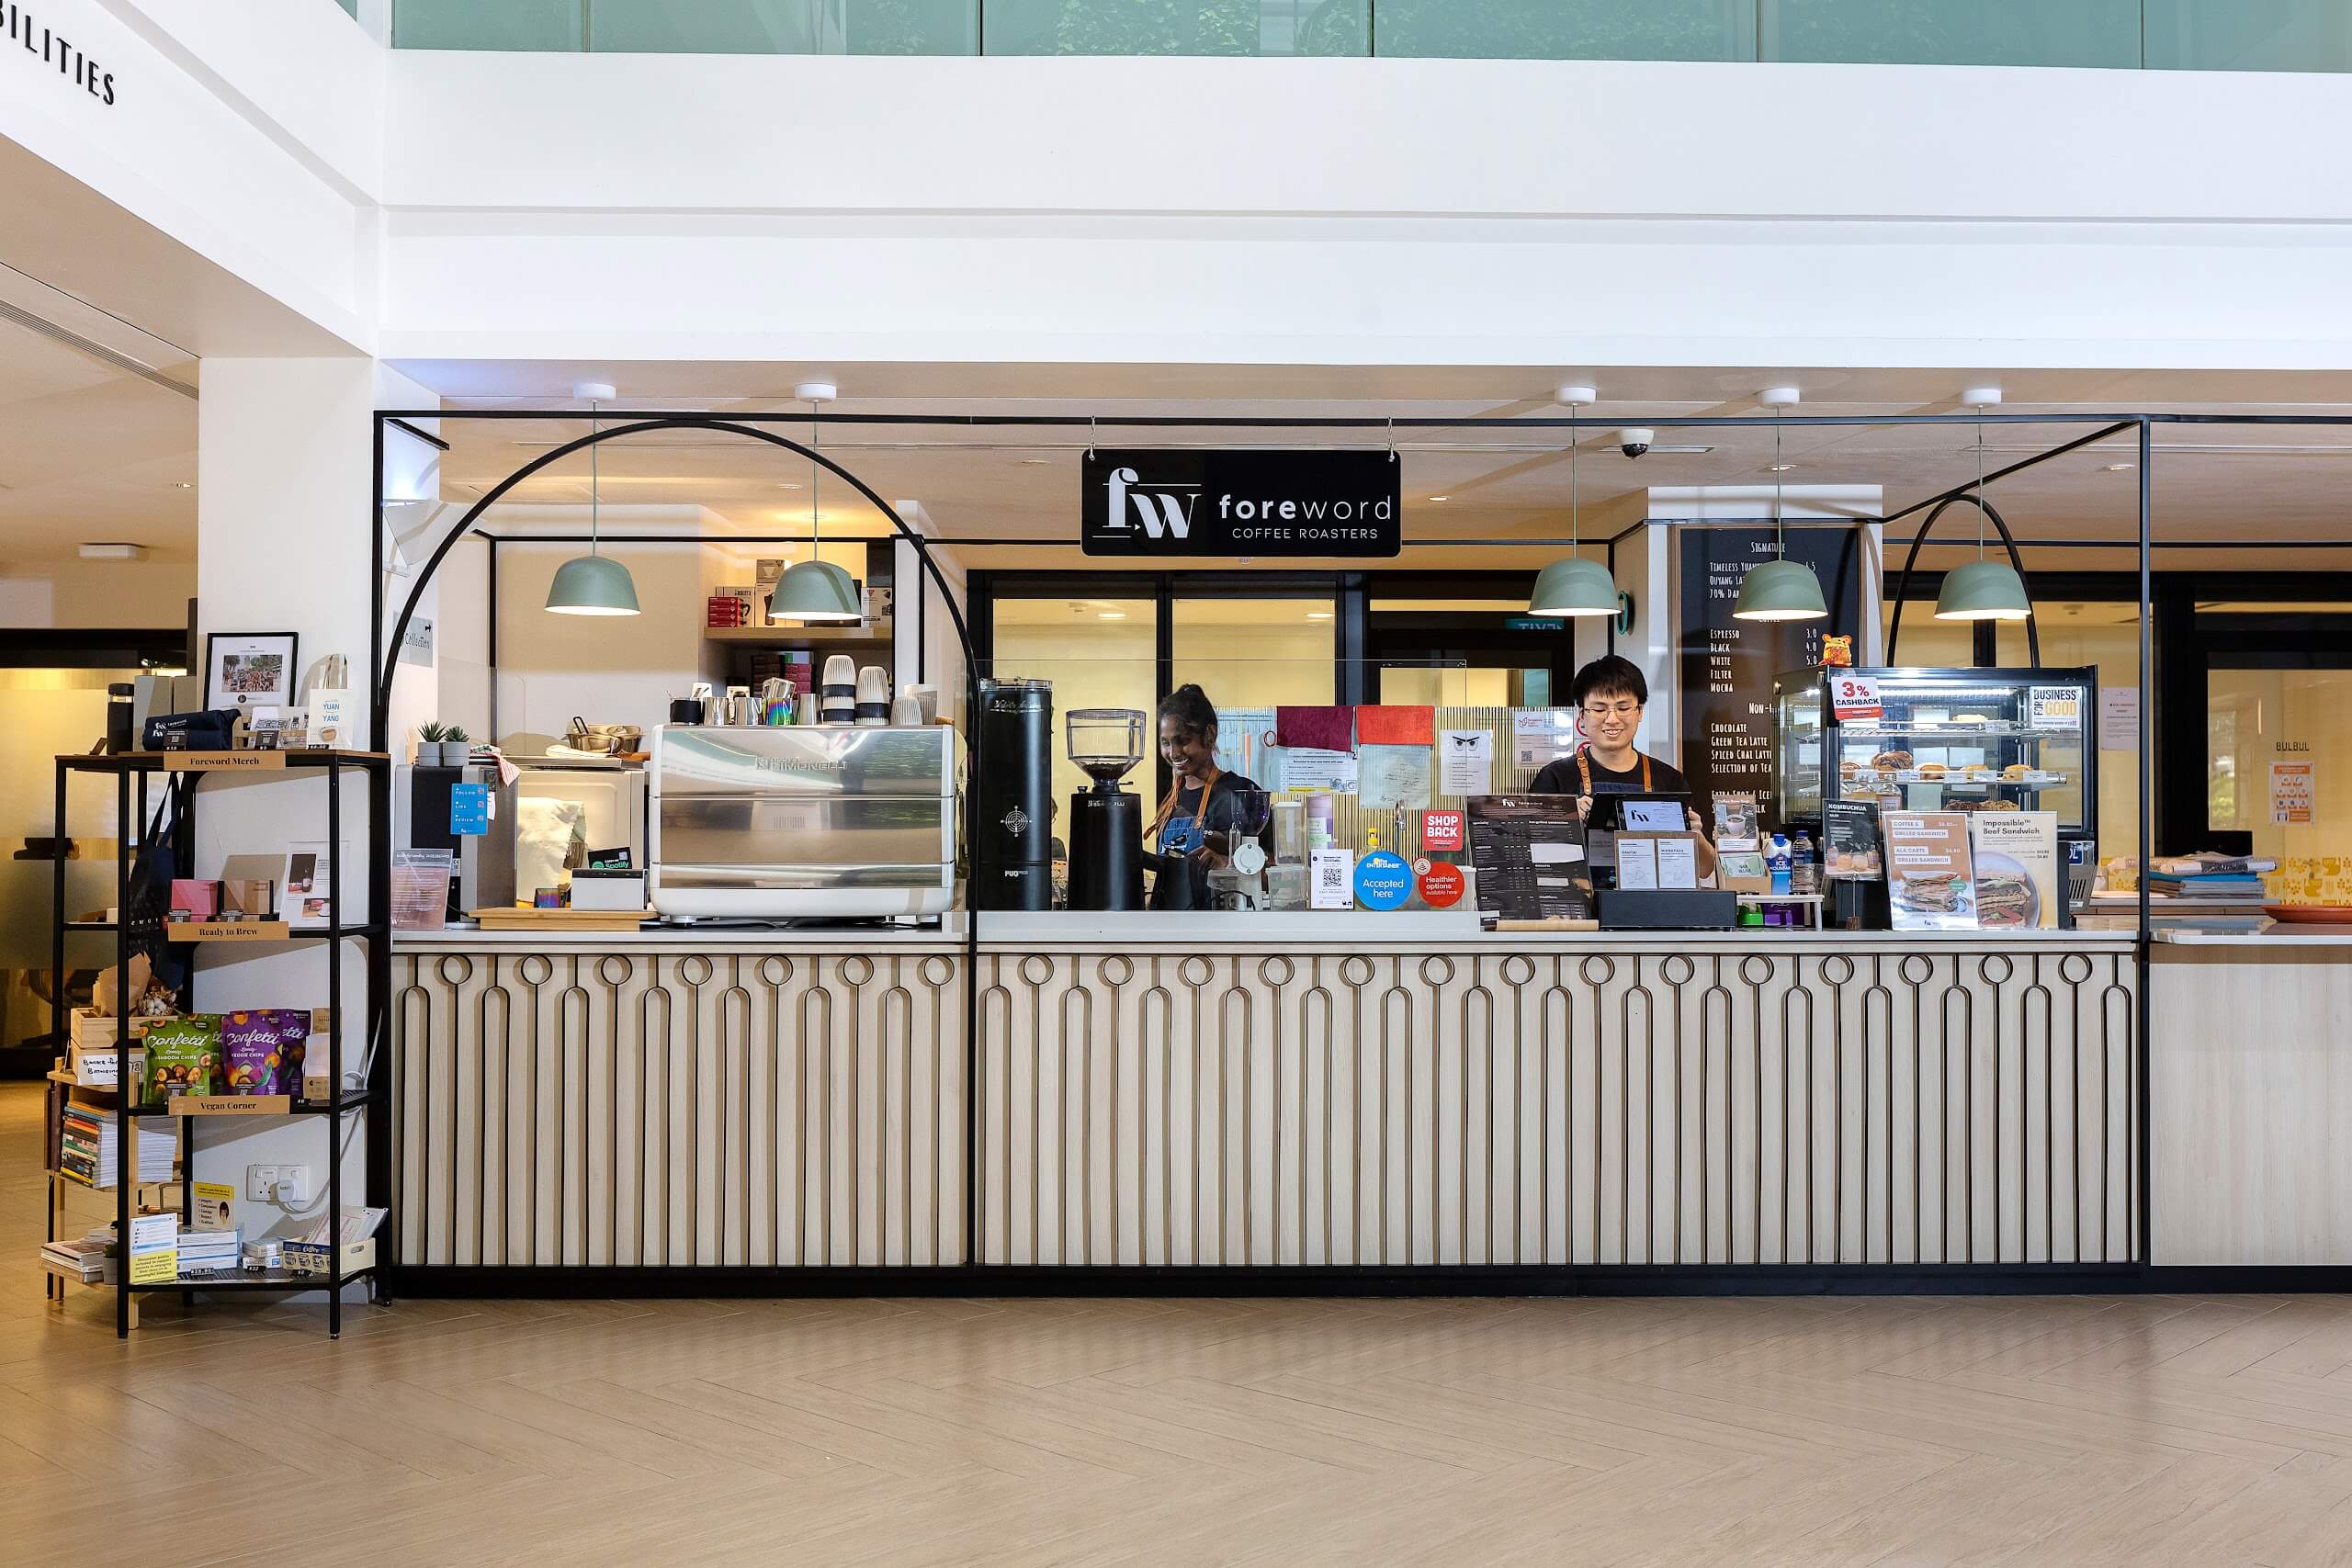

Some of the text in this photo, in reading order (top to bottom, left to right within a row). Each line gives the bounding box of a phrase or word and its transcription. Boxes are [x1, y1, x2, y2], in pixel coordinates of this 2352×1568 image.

[1219, 494, 1391, 520] foreword
[1232, 528, 1379, 539] COFFEE ROASTERS
[1750, 541, 1786, 553] SIGNATUE
[1710, 643, 1731, 653] BLACK
[1710, 656, 1731, 666] WHITE
[2033, 689, 2076, 701] BUSINESS
[1748, 703, 1771, 714] NON-
[2033, 701, 2043, 716] FOR
[2045, 701, 2077, 715] GOOD
[1711, 723, 1747, 733] CHOCOLATE
[1711, 736, 1768, 747] GREEN TEA LATTE
[2276, 741, 2310, 751] BULBUL
[1711, 750, 1735, 760] SPICED
[1736, 750, 1753, 760] CHAI
[190, 757, 259, 765] Foreword Merch
[1711, 763, 1747, 773] SELECTION
[1427, 815, 1458, 826] SHOP
[1427, 826, 1458, 837] BACK
[1363, 878, 1404, 890] Accepted
[1373, 888, 1394, 898] here
[199, 929, 223, 937] Ready
[147, 1032, 209, 1049] Confetti
[226, 1029, 280, 1047] Confetti
[200, 1102, 225, 1111] Vegan
